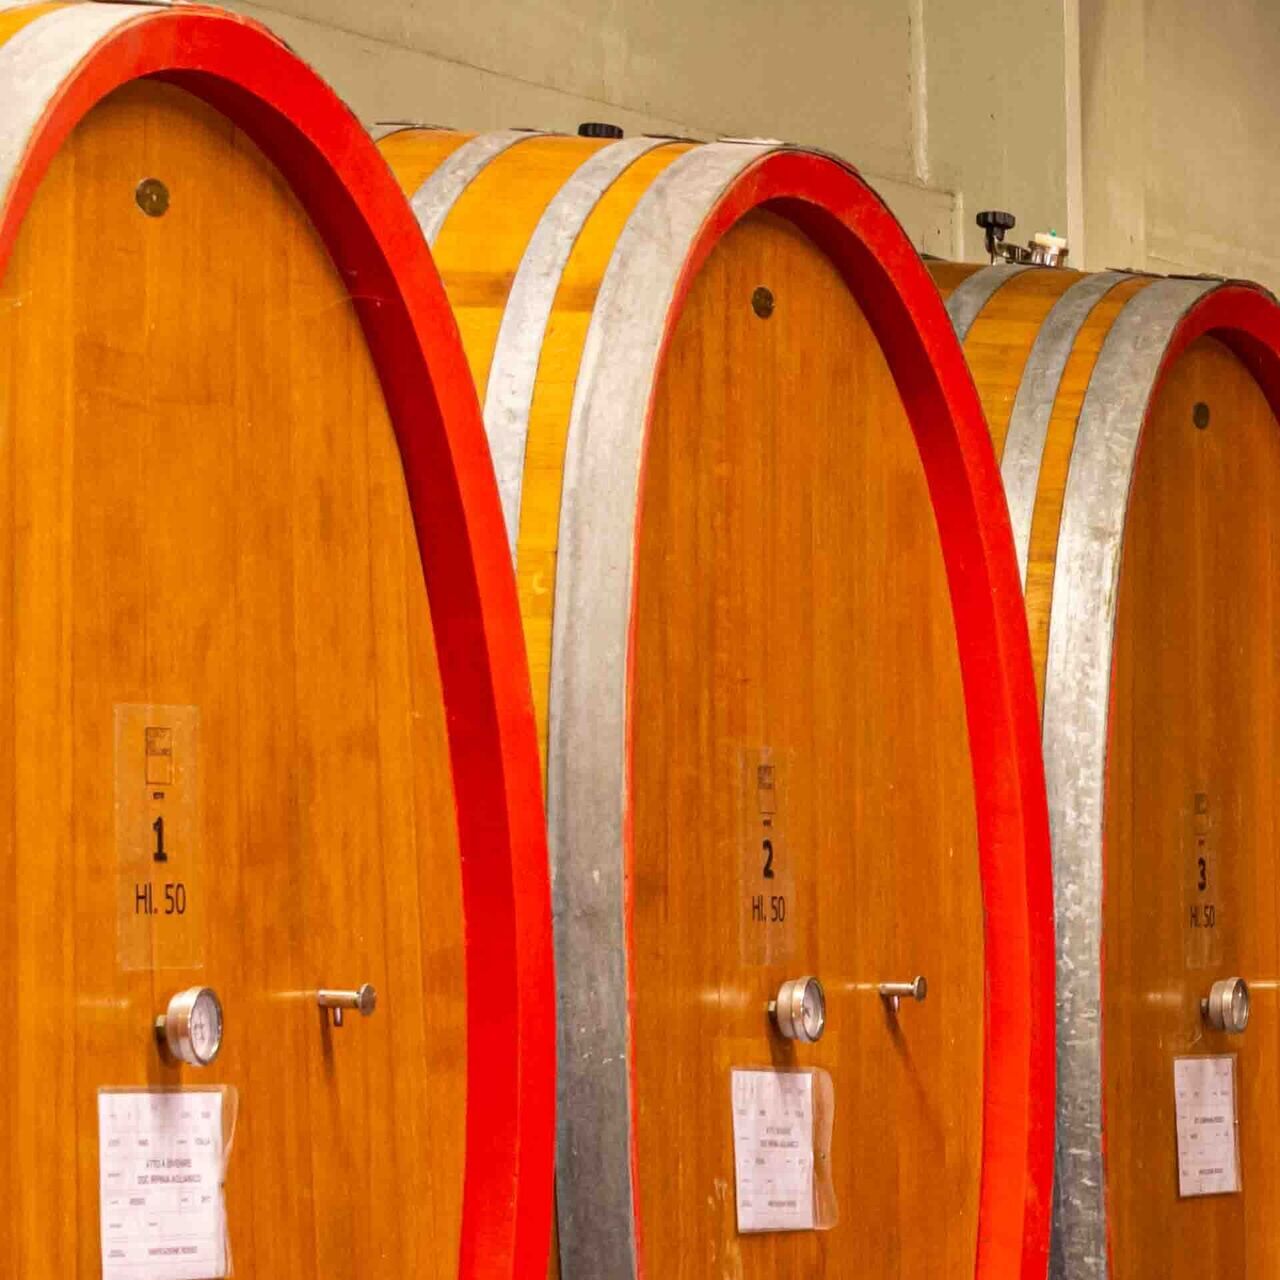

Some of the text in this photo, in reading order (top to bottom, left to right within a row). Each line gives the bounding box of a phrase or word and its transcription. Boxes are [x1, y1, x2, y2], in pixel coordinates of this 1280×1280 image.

[152, 816, 168, 863] 1
[763, 839, 775, 879] 2
[1198, 857, 1207, 891] 3
[165, 883, 187, 915] 50
[771, 896, 786, 923] 50
[1204, 904, 1216, 928] 50
